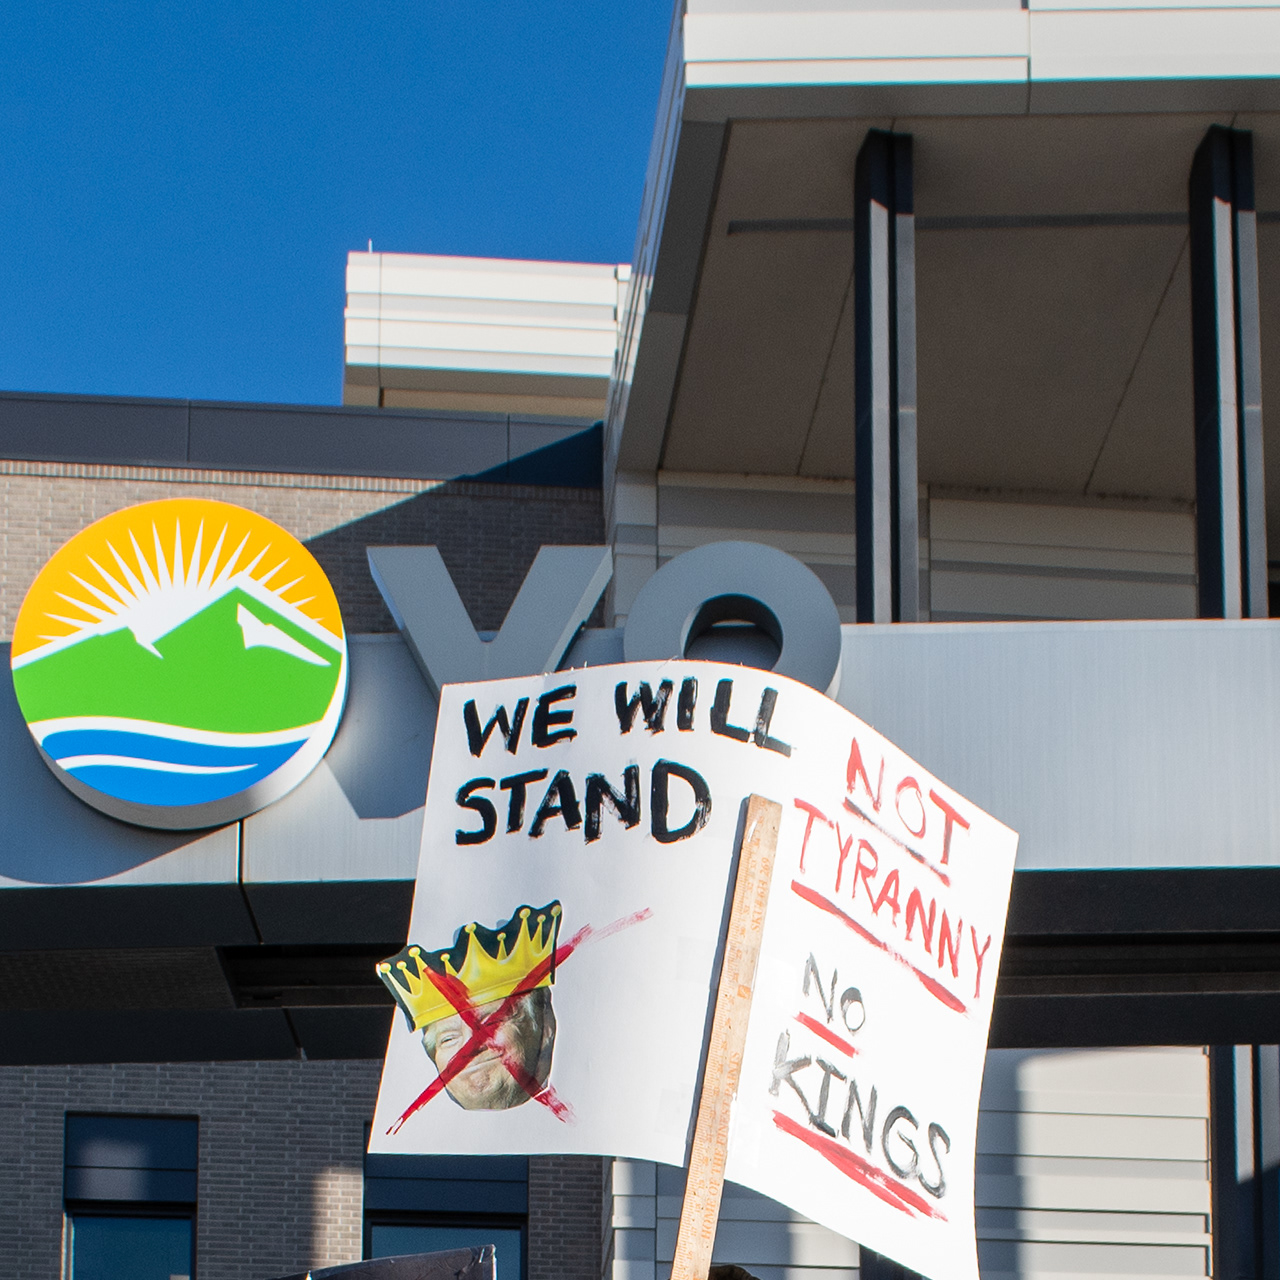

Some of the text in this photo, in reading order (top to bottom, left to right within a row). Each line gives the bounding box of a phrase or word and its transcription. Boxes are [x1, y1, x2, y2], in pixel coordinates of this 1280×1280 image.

[463, 677, 791, 757] WE WILL
[456, 759, 712, 844] STAND
[846, 737, 970, 866] NOT
[794, 798, 991, 999] TYRANNY
[804, 952, 865, 1031] NO
[769, 1029, 950, 1198] KINGS
[700, 1198, 716, 1240] HOME
[707, 1177, 720, 1196] OF
